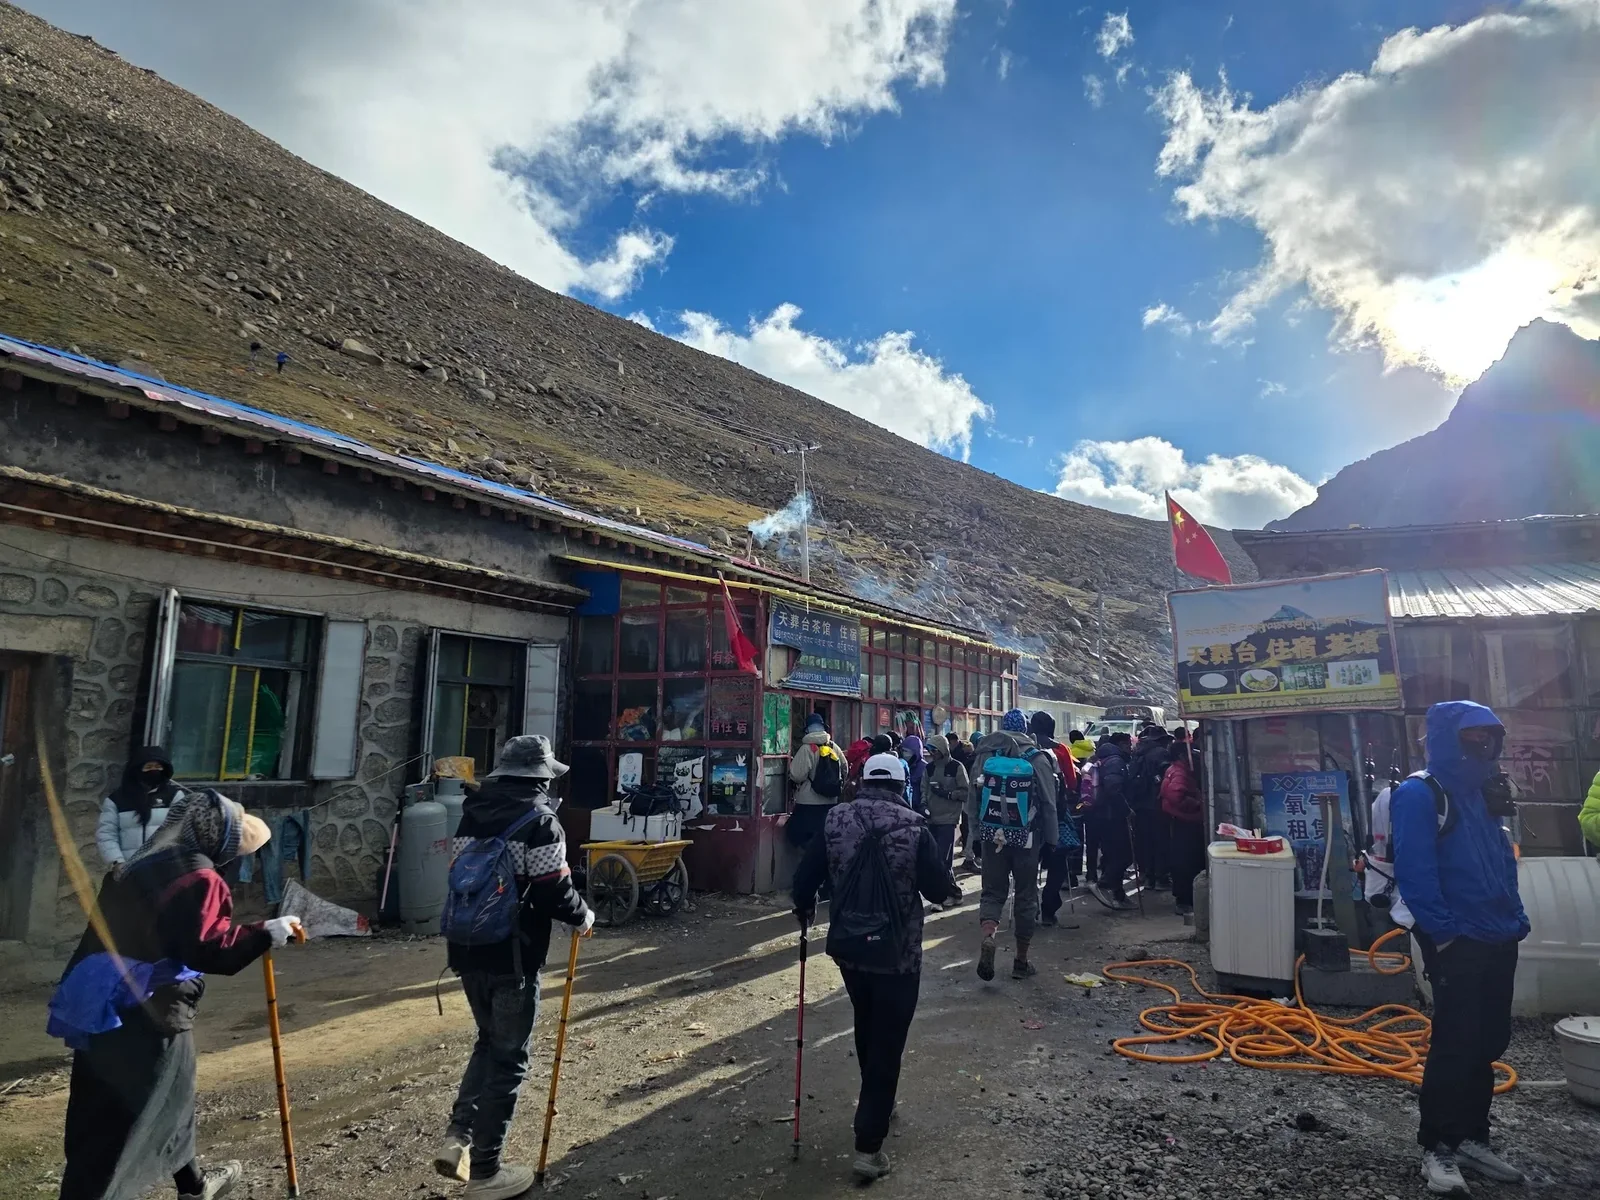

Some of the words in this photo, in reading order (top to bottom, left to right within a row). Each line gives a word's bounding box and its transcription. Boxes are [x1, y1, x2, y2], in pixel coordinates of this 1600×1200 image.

[778, 611, 832, 636] 天葬台茶馆
[840, 624, 857, 641] 住宿
[1186, 641, 1257, 667] 天葬台
[1266, 635, 1317, 662] 住宿
[1325, 630, 1380, 659] 茶馆
